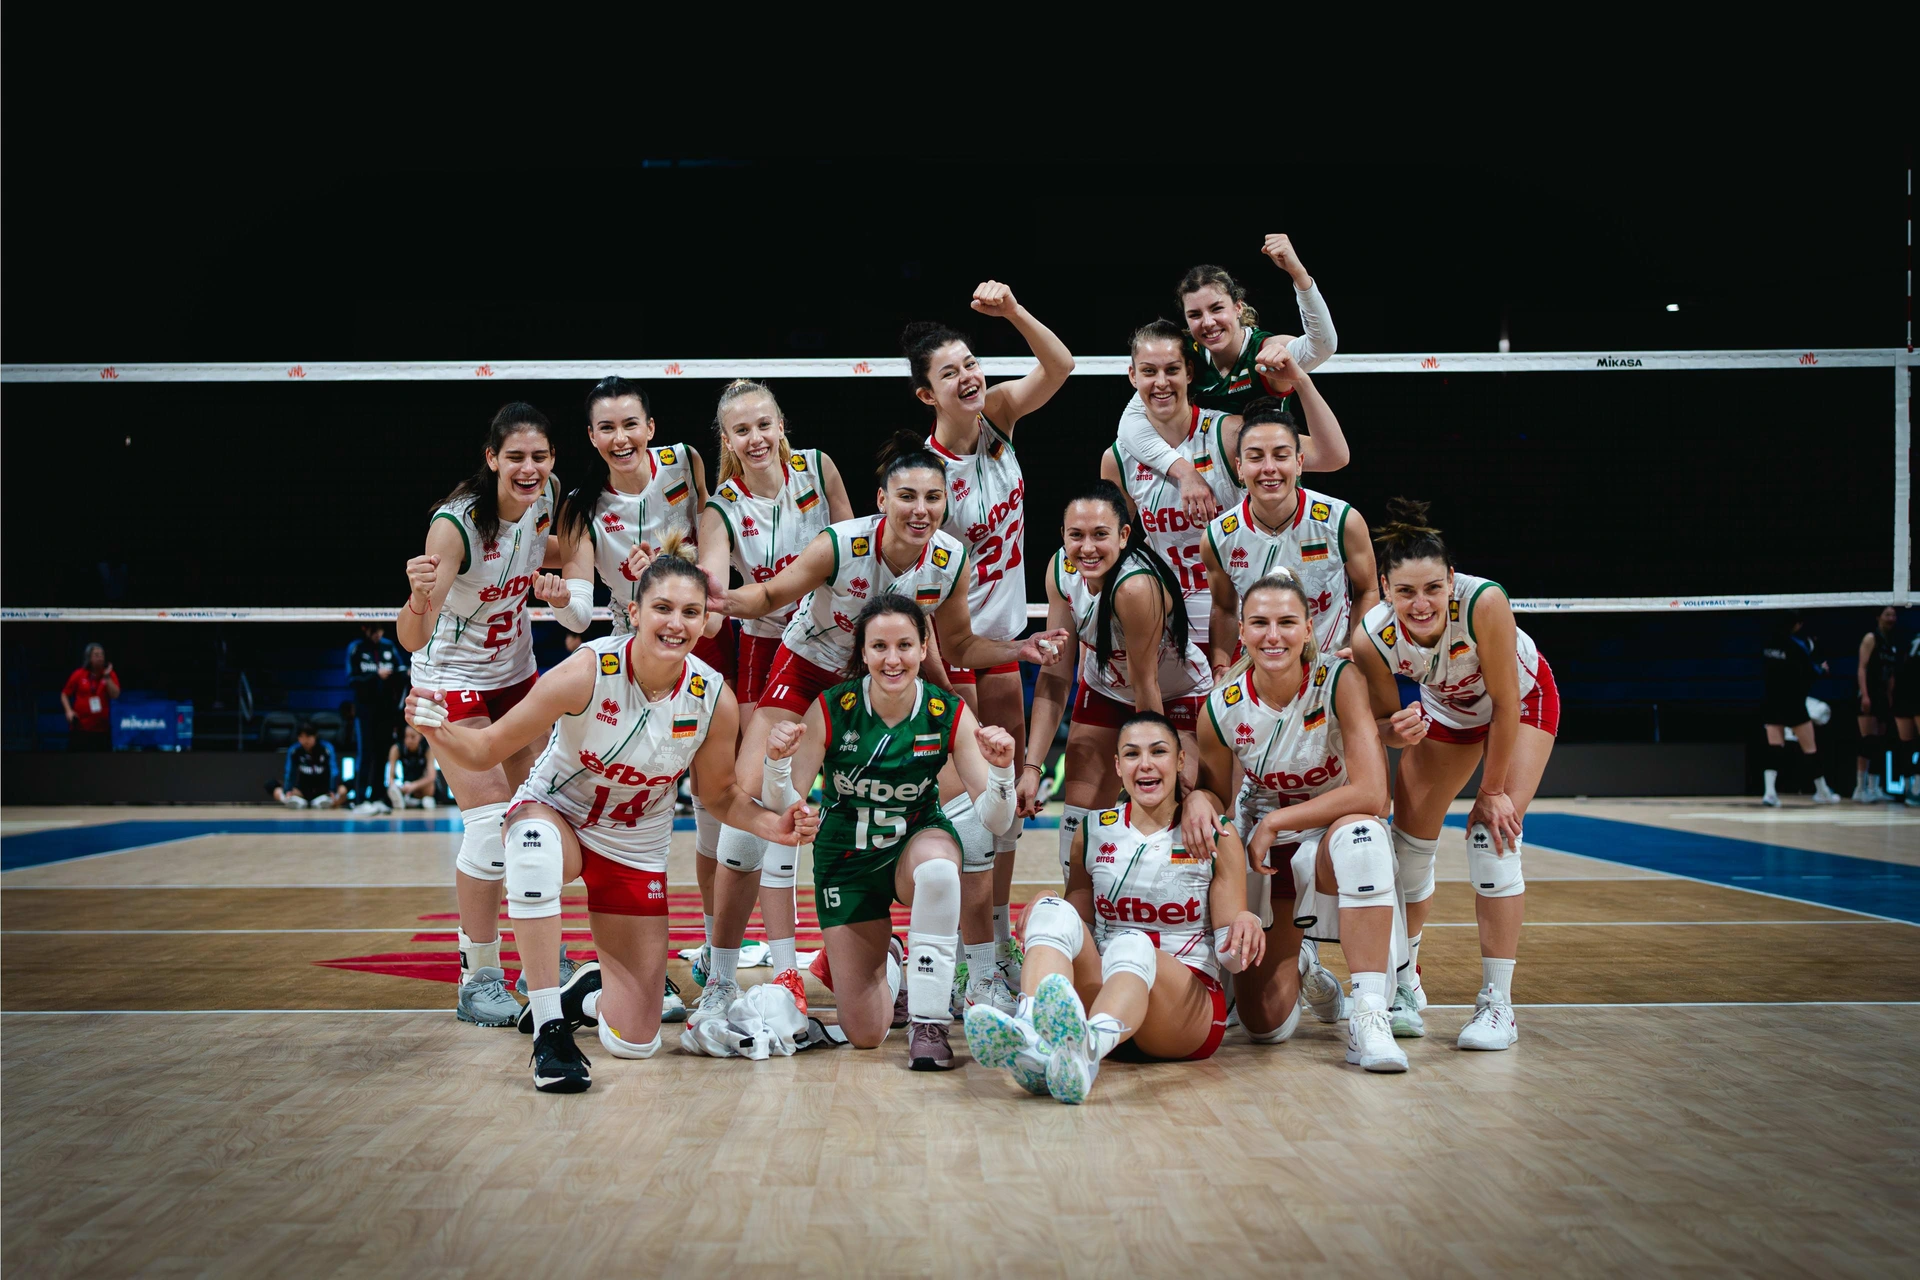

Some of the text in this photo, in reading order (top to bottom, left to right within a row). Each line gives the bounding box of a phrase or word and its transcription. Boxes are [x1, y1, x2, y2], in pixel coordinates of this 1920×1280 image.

[1421, 356, 1440, 369] VNL
[1799, 352, 1819, 365] VNL
[100, 366, 119, 379] VNL
[605, 524, 625, 533] errea
[483, 551, 501, 562] errea
[1167, 545, 1209, 590] 12
[771, 684, 790, 700] 11
[596, 712, 618, 726] errea
[580, 753, 684, 787] efbet
[1245, 755, 1342, 790] efbet
[833, 774, 932, 802] efbet
[586, 785, 651, 827] 14
[855, 806, 907, 849] 15
[1353, 836, 1371, 844] errea
[823, 887, 841, 909] 15
[1095, 896, 1200, 924] efbet
